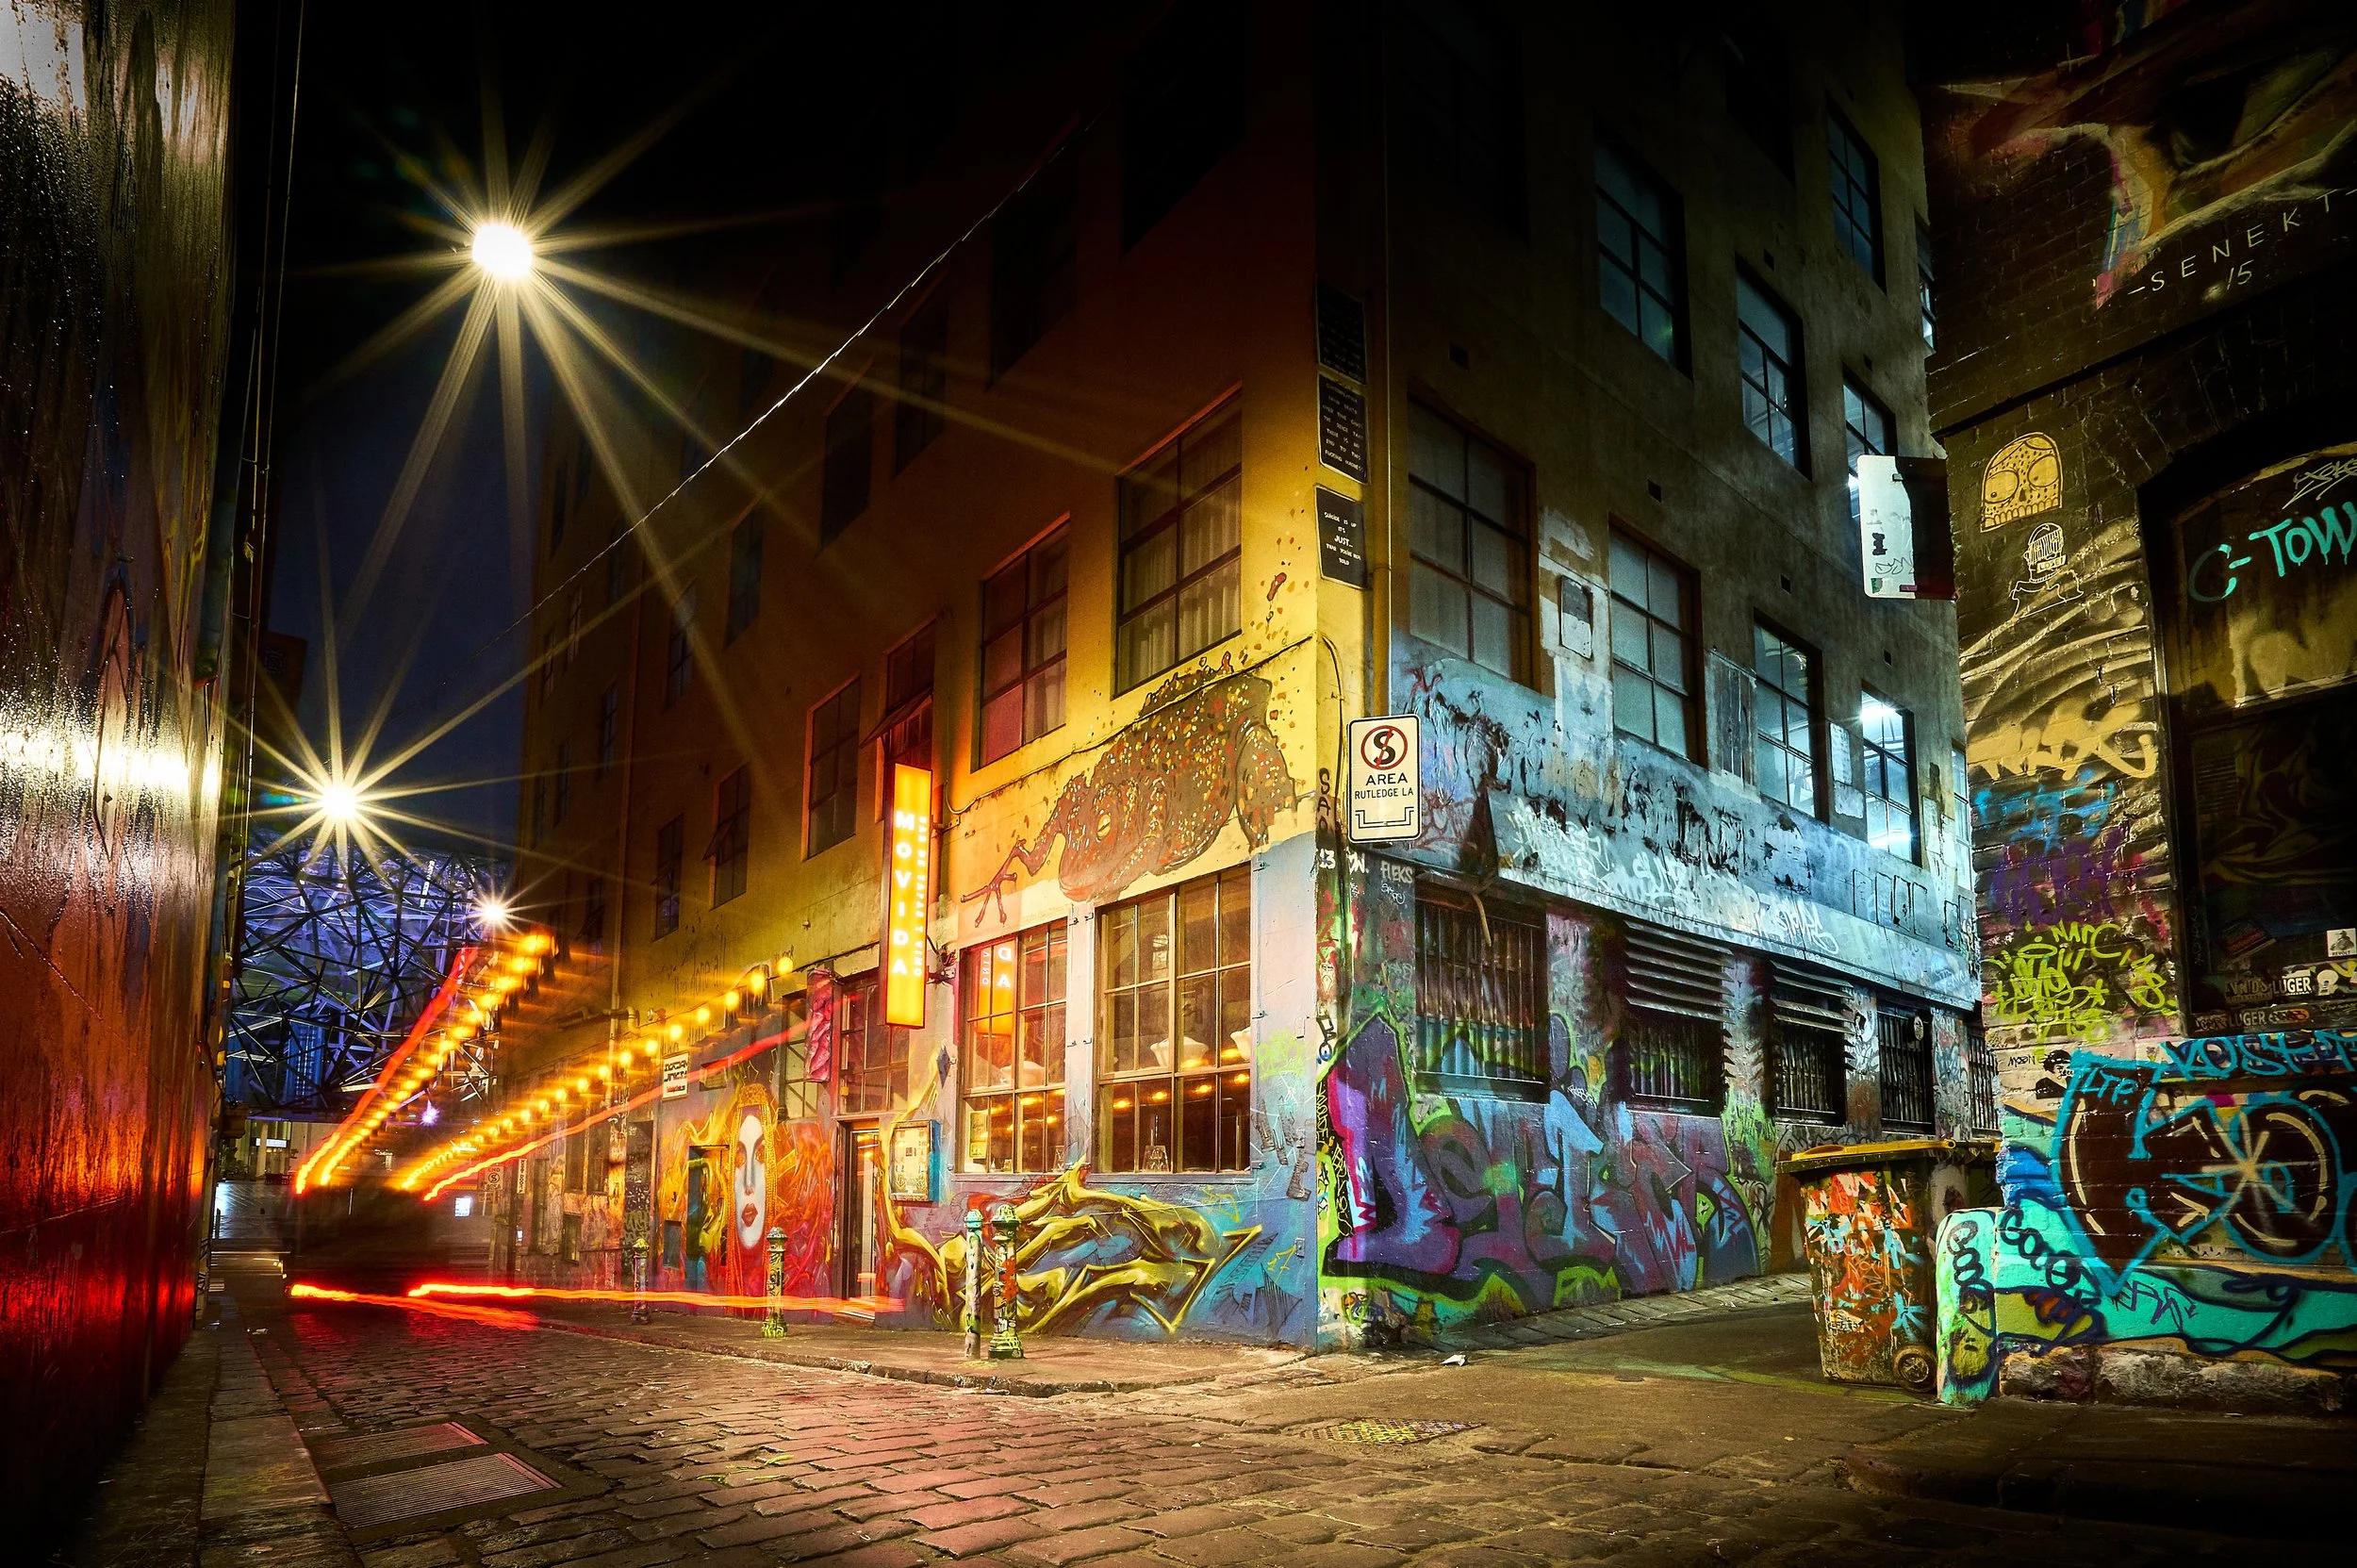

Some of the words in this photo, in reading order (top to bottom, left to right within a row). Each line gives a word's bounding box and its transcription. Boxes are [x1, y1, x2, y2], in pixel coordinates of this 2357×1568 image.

[1365, 772, 1409, 786] AREA
[1354, 788, 1399, 800] RUTLEDGE
[1402, 786, 1414, 797] LA
[891, 810, 915, 976] MOVIDA
[914, 941, 924, 977] VINO
